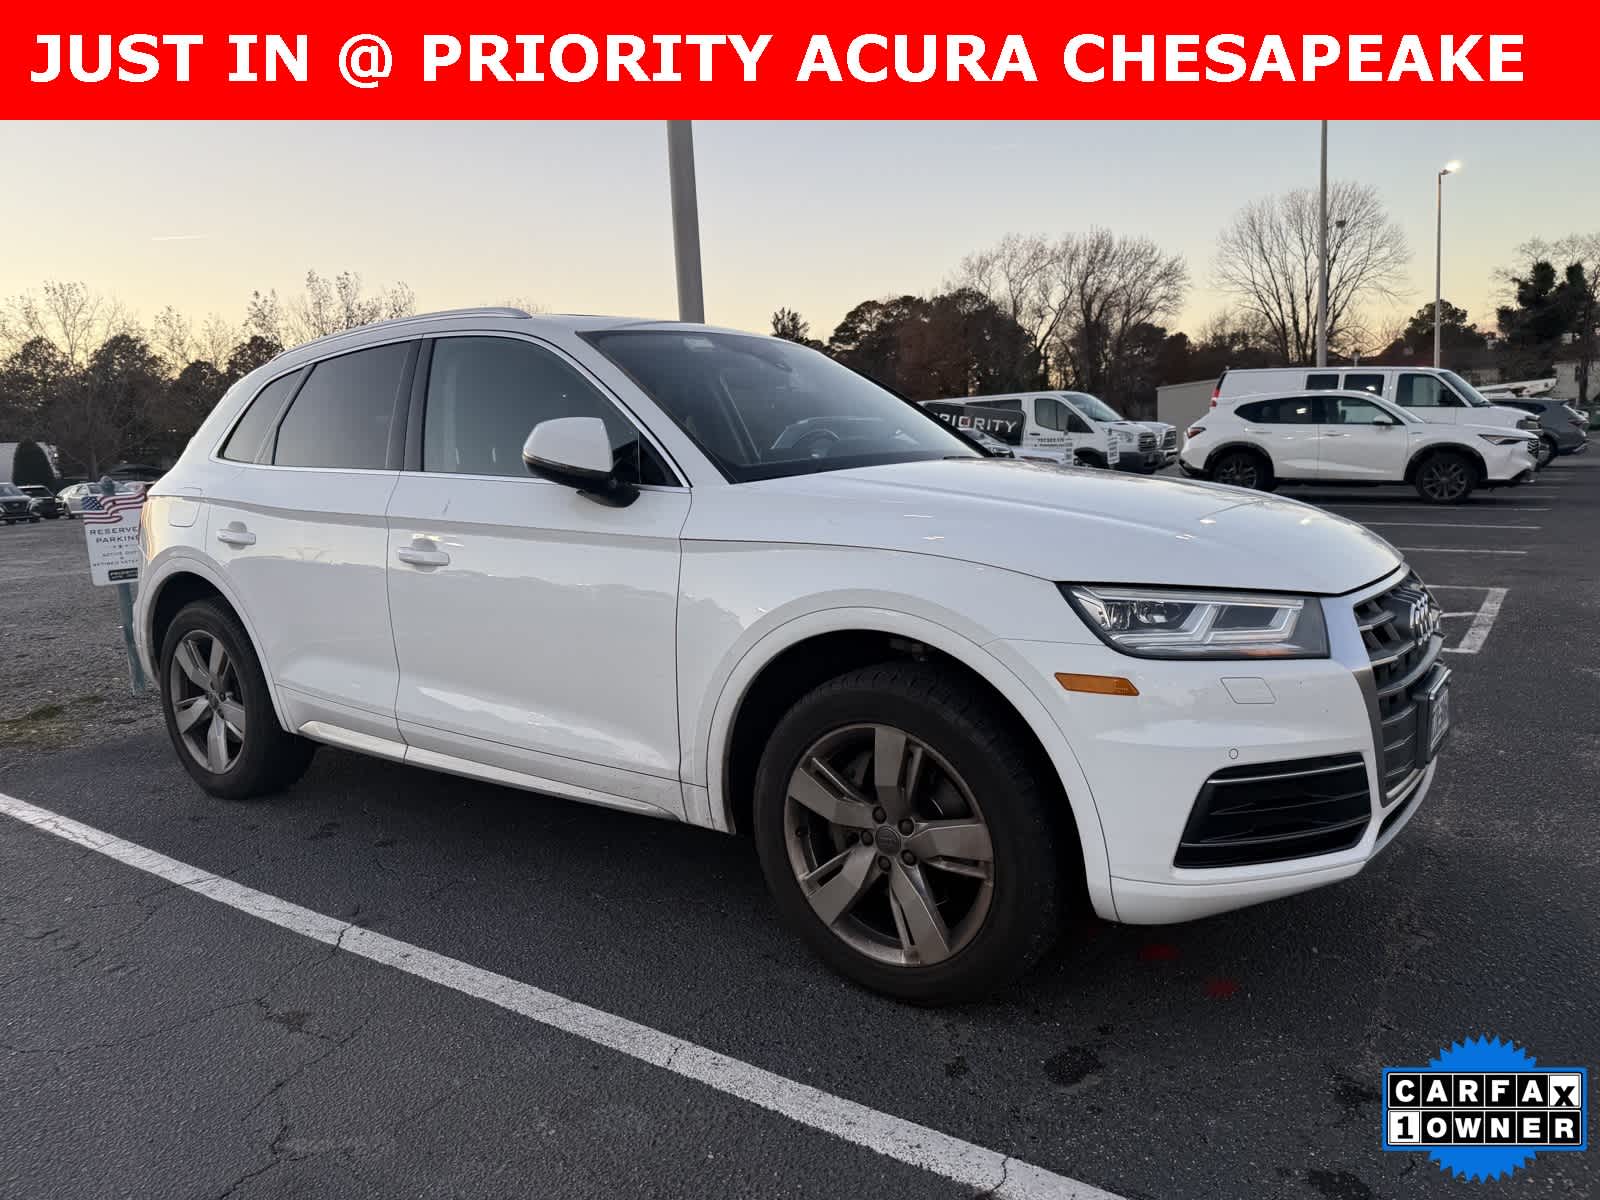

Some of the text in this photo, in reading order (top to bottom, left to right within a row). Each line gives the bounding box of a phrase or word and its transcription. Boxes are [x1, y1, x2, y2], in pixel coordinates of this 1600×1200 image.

[934, 412, 1017, 433] RIORITY
[89, 526, 138, 535] RESERVE
[96, 535, 138, 543] PARKIN
